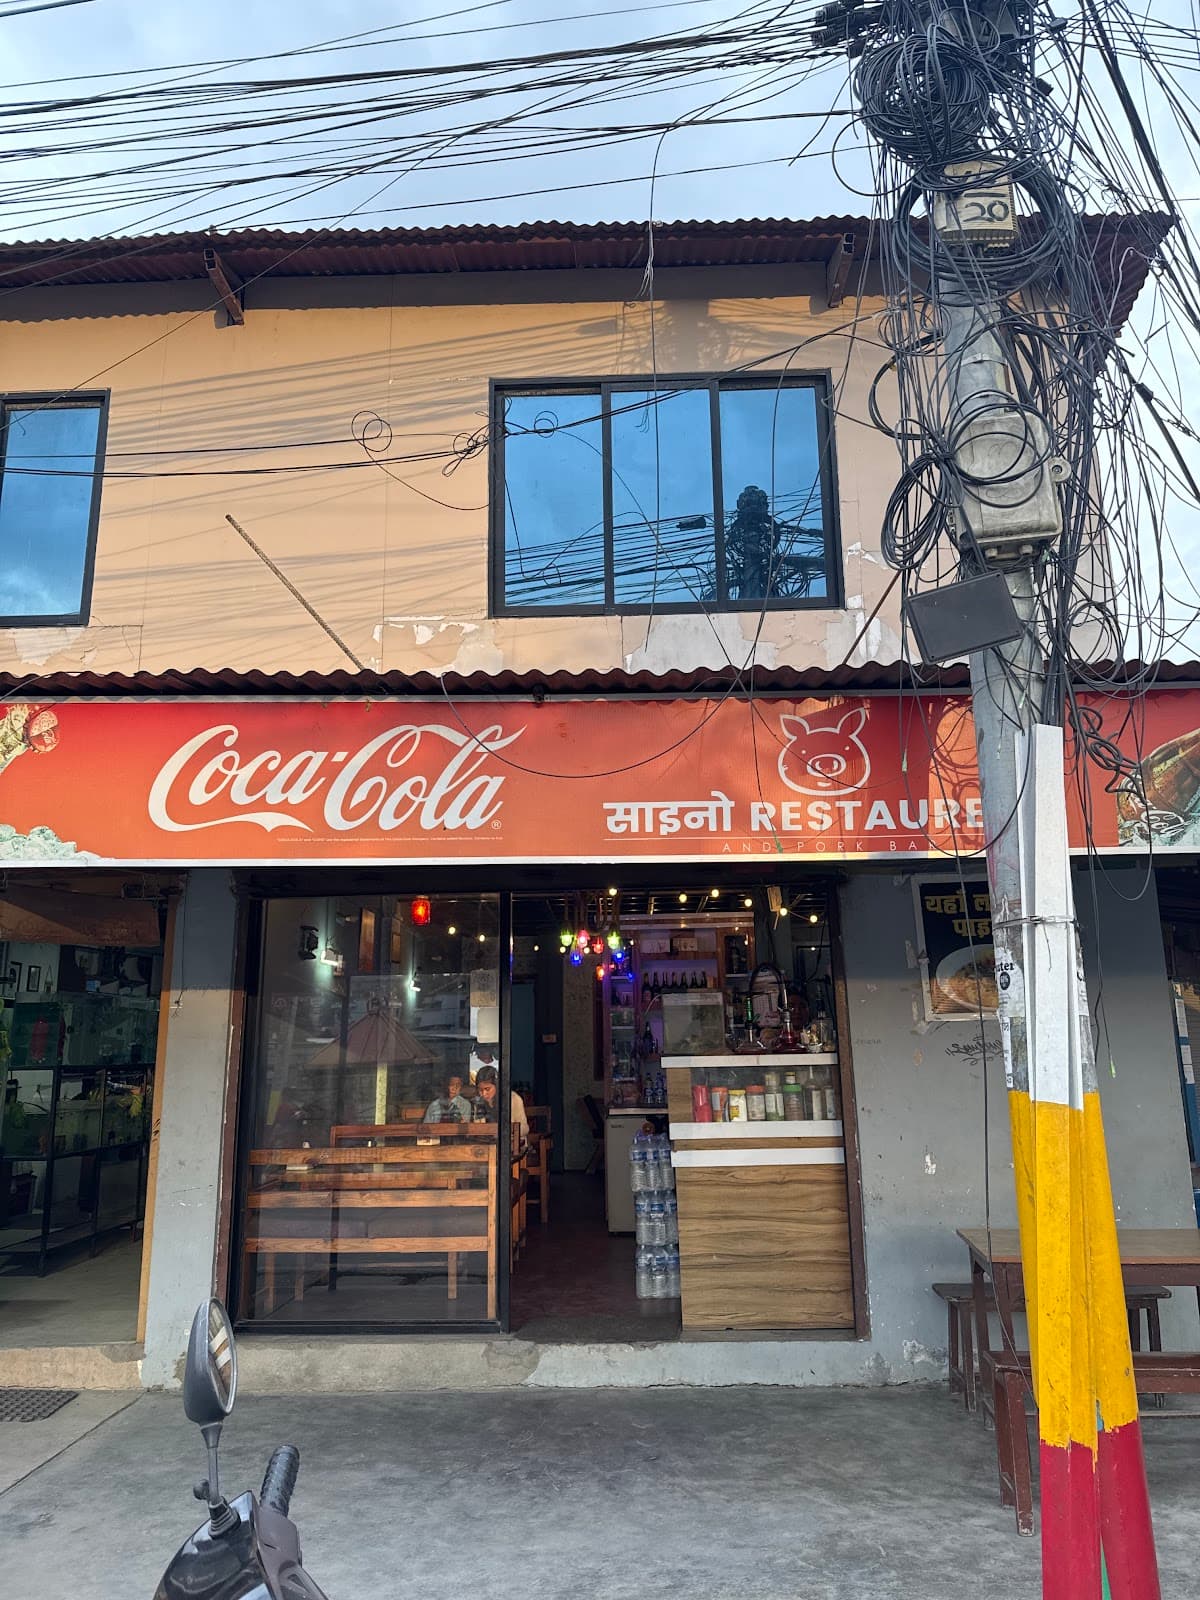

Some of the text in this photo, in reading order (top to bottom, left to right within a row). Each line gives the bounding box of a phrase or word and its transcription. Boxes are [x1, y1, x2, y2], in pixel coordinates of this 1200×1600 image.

[963, 200, 1010, 222] 20
[148, 724, 527, 832] Coca-Cola
[603, 790, 735, 835] साइनो
[722, 840, 937, 852] AND PORK BAR
